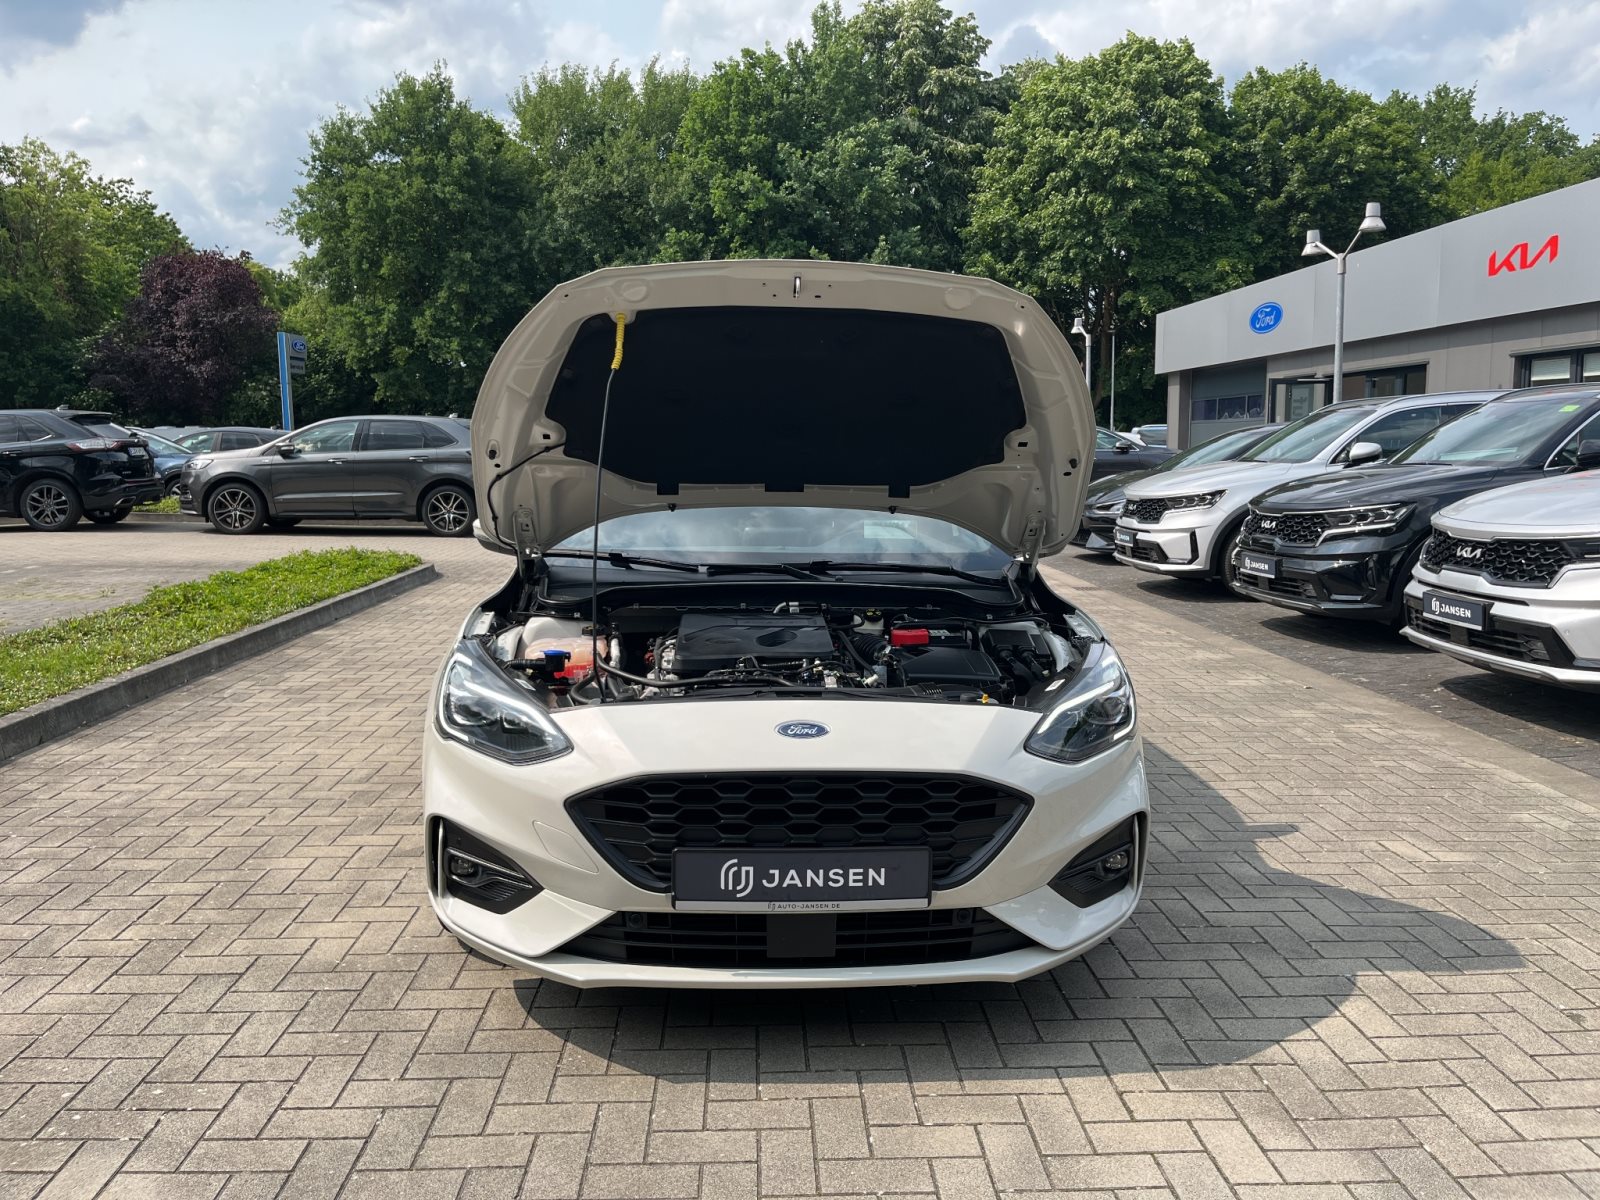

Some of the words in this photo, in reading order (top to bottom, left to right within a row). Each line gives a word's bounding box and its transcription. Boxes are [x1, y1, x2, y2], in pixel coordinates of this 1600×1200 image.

[1488, 235, 1559, 277] KIA
[1256, 308, 1276, 328] Ford
[1456, 545, 1482, 559] KIA
[1250, 561, 1269, 570] JANSEN
[1440, 603, 1471, 618] JANSEN
[787, 724, 818, 735] Ford
[762, 867, 886, 888] JANSEN
